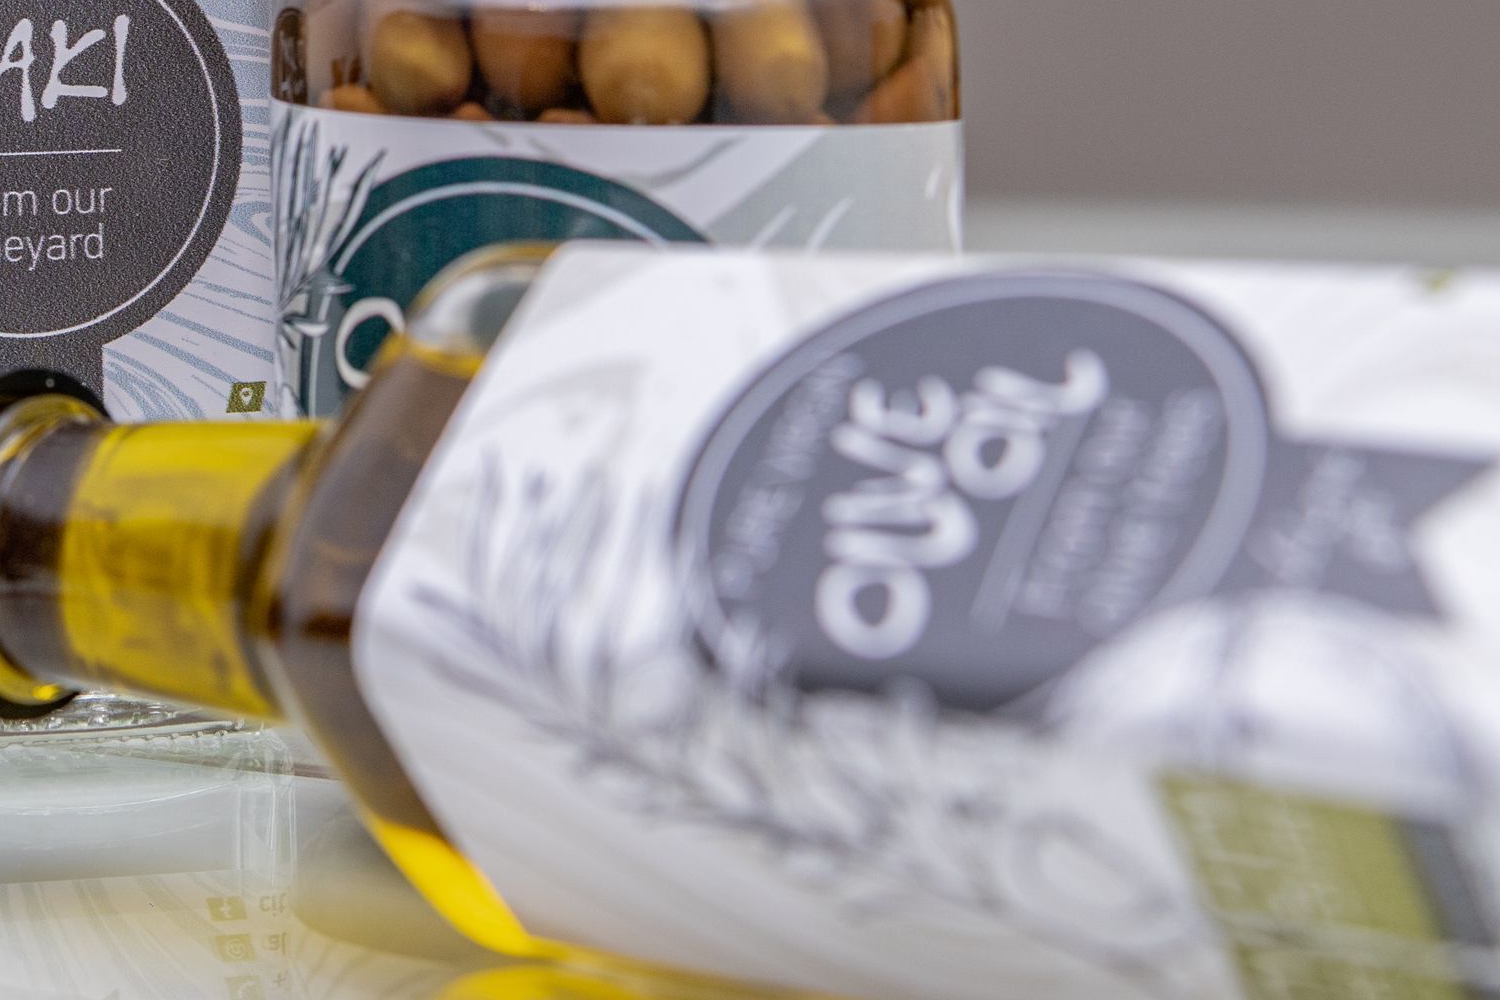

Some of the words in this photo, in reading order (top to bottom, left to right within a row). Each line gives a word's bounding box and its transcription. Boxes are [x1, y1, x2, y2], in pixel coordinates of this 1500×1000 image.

[51, 187, 113, 215] our
[945, 348, 1109, 500] OIL
[813, 373, 980, 660] OLIVE
